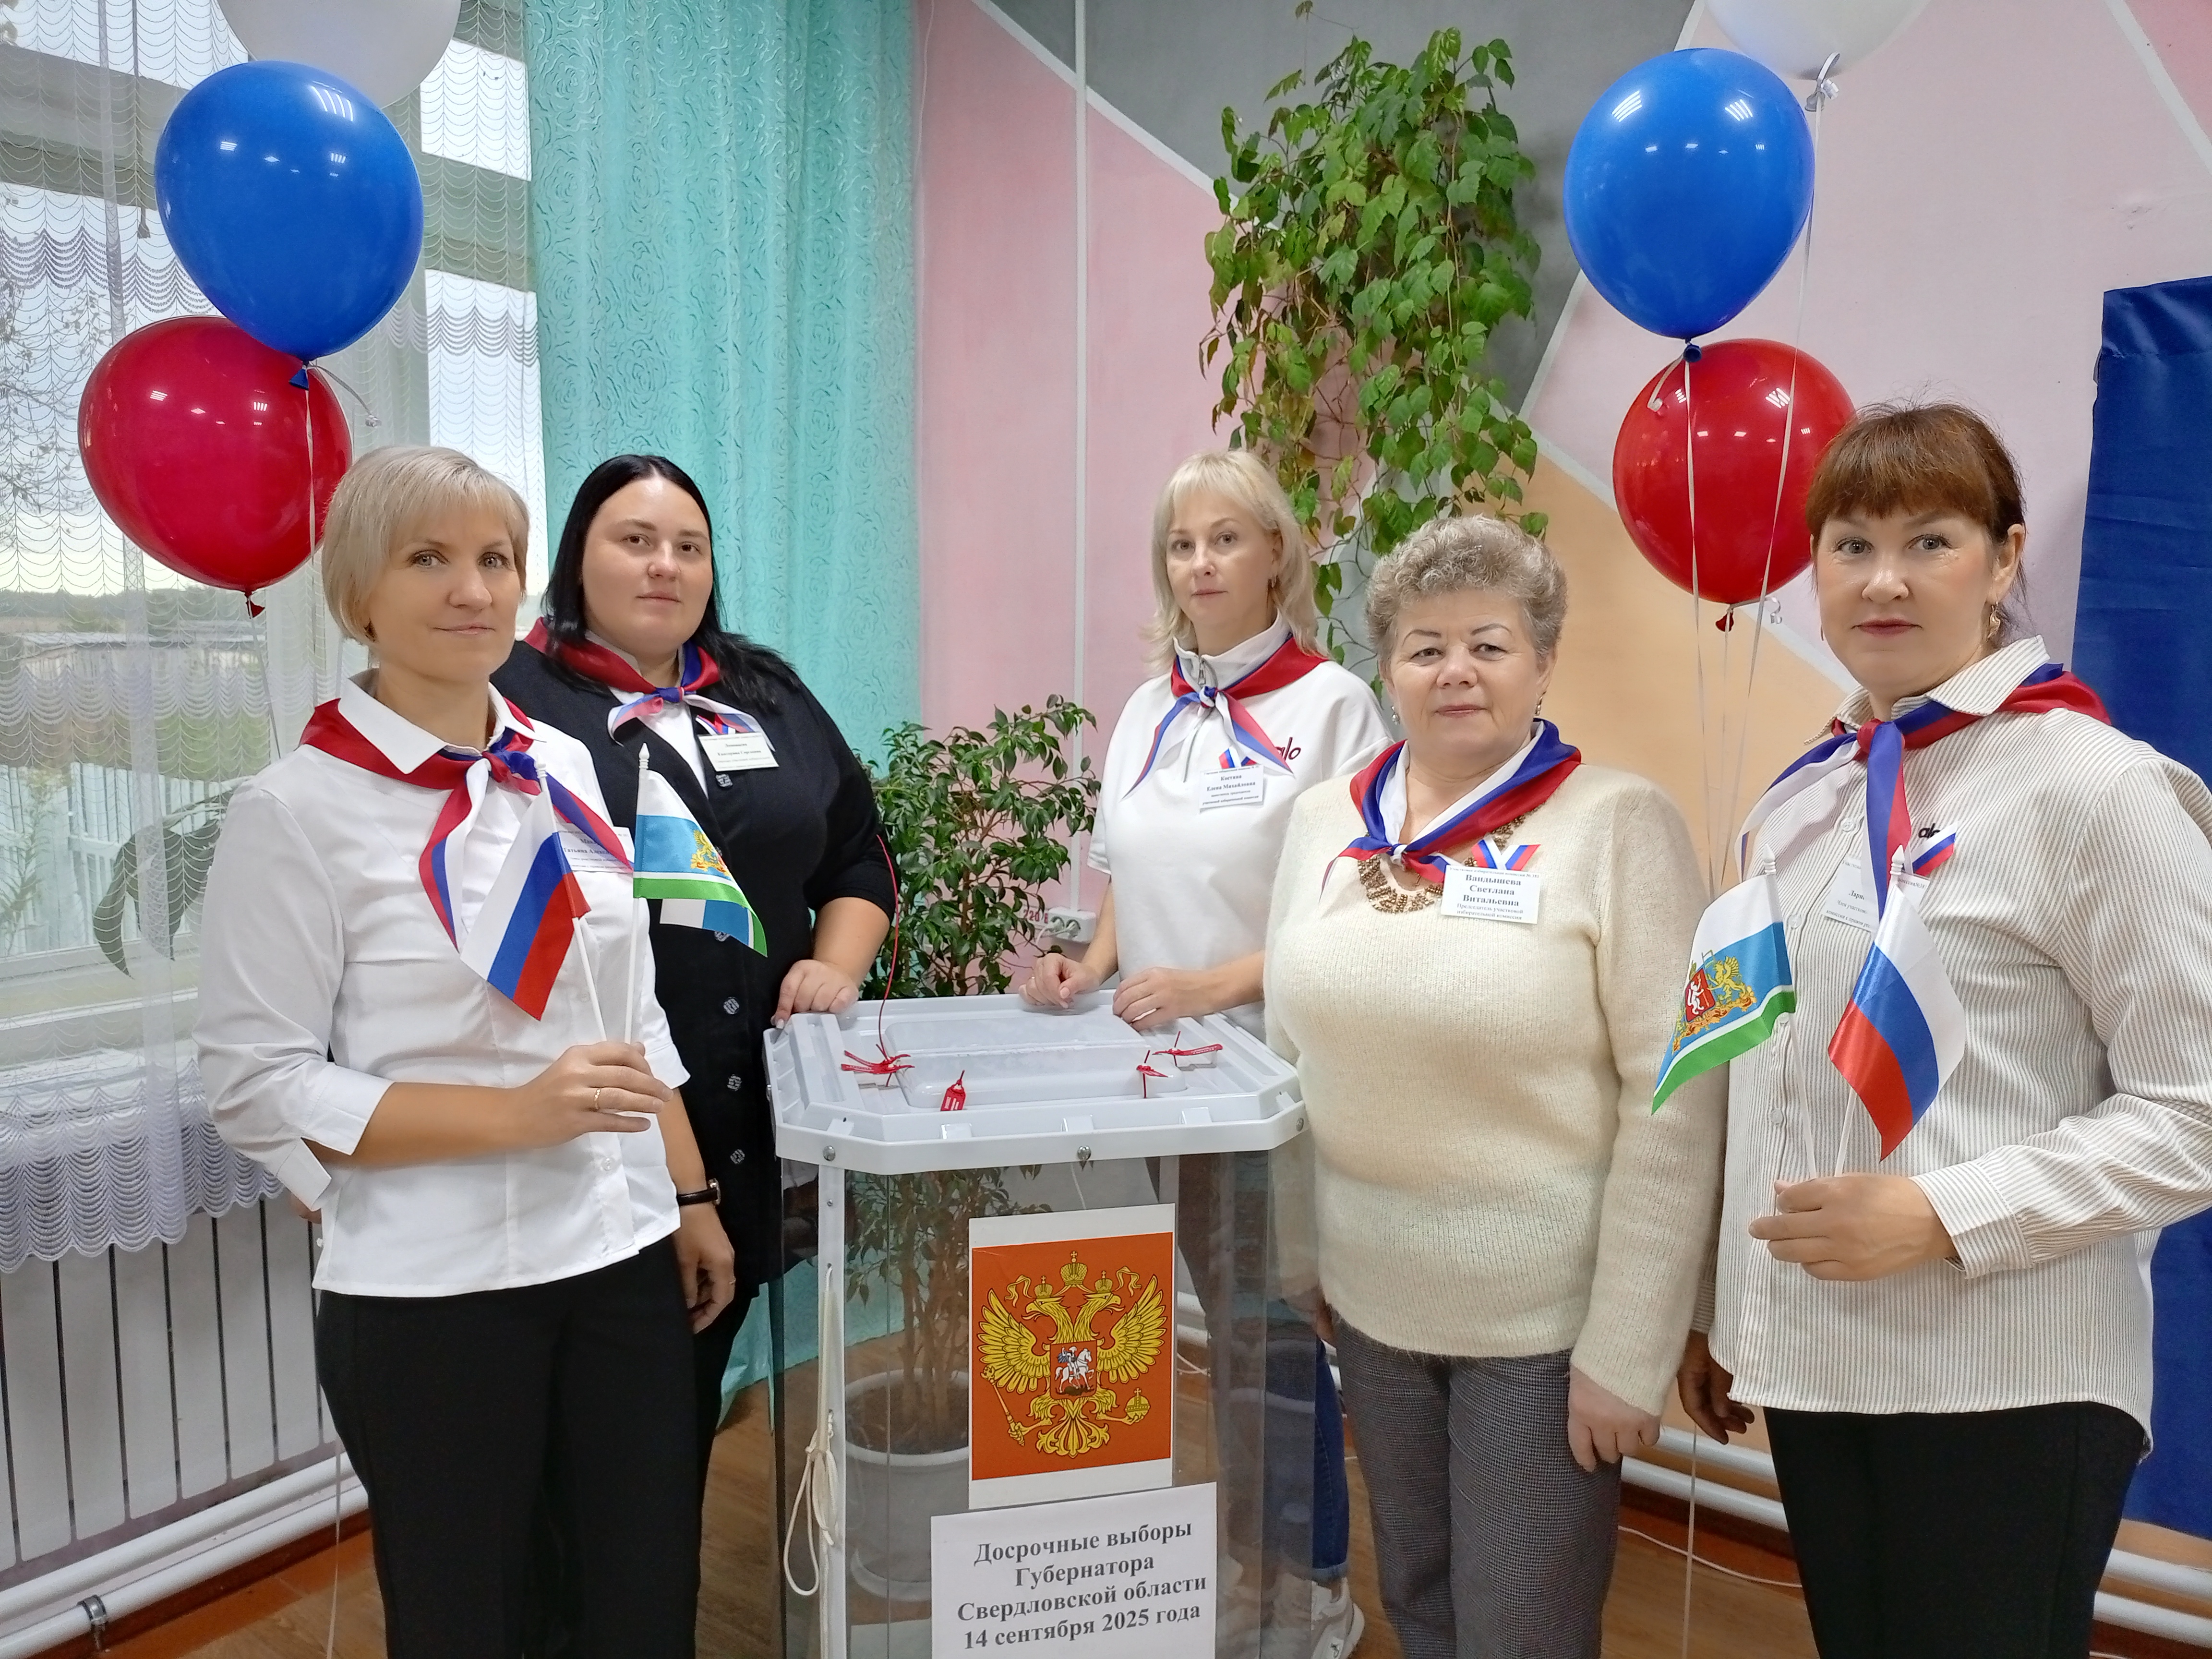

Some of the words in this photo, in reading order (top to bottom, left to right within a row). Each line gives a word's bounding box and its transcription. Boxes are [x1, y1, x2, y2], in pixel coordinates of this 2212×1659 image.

[1466, 874, 1521, 886] Вандышева
[1469, 885, 1515, 895] Светлана
[1463, 895, 1519, 906] Витальевна
[974, 1535, 1100, 1566] Досрочные
[1106, 1521, 1192, 1548] выборы
[1014, 1556, 1154, 1589] Губернатора
[958, 1586, 1117, 1624] Свердловской
[1124, 1577, 1206, 1601] области
[964, 1630, 988, 1649] 14
[995, 1618, 1095, 1646] сентября
[1101, 1608, 1150, 1632] 2025
[1156, 1606, 1201, 1625] года
